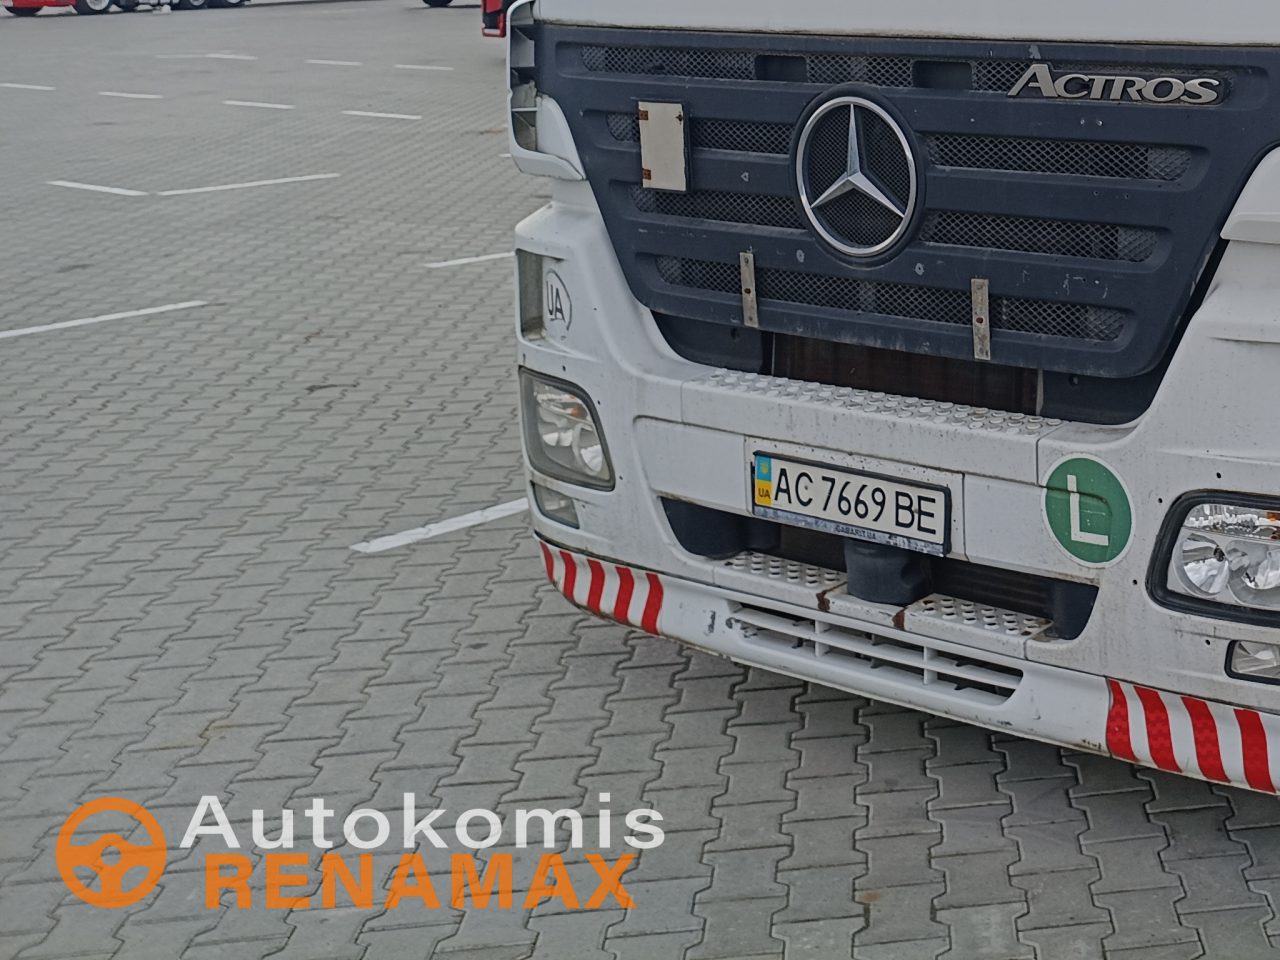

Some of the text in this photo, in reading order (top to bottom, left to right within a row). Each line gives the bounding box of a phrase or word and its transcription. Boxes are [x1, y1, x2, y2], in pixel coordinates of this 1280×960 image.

[546, 280, 566, 323] UA
[758, 487, 771, 499] UA
[774, 468, 814, 507] AC
[821, 476, 886, 522] 7669
[895, 490, 936, 535] BE
[1066, 474, 1109, 547] L
